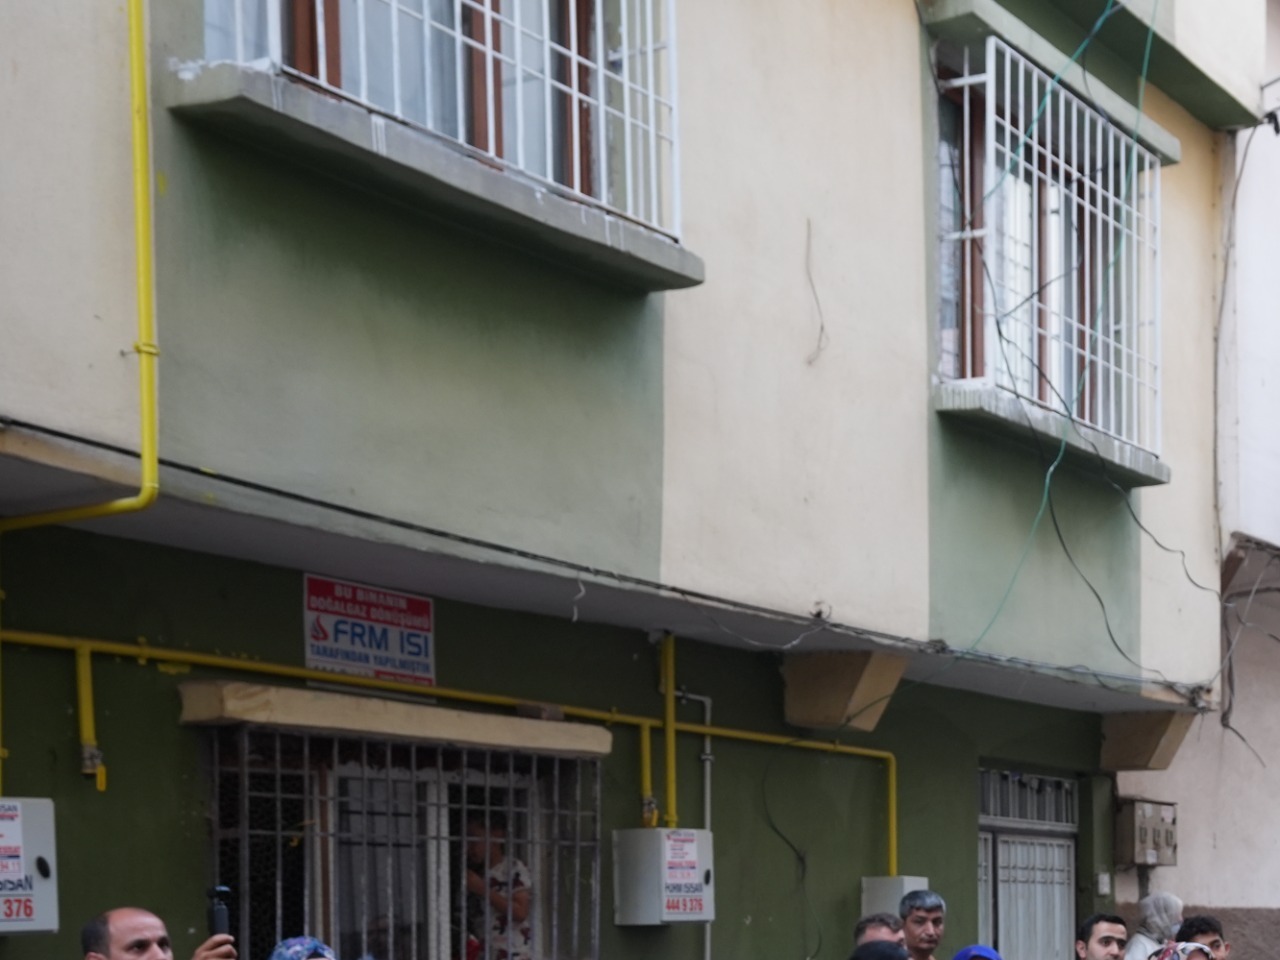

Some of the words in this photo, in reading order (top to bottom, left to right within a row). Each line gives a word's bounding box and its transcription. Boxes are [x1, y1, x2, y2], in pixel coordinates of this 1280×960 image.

[333, 619, 389, 652] FRM
[400, 631, 429, 658] ISI
[4, 898, 33, 918] 376
[665, 896, 680, 911] 444
